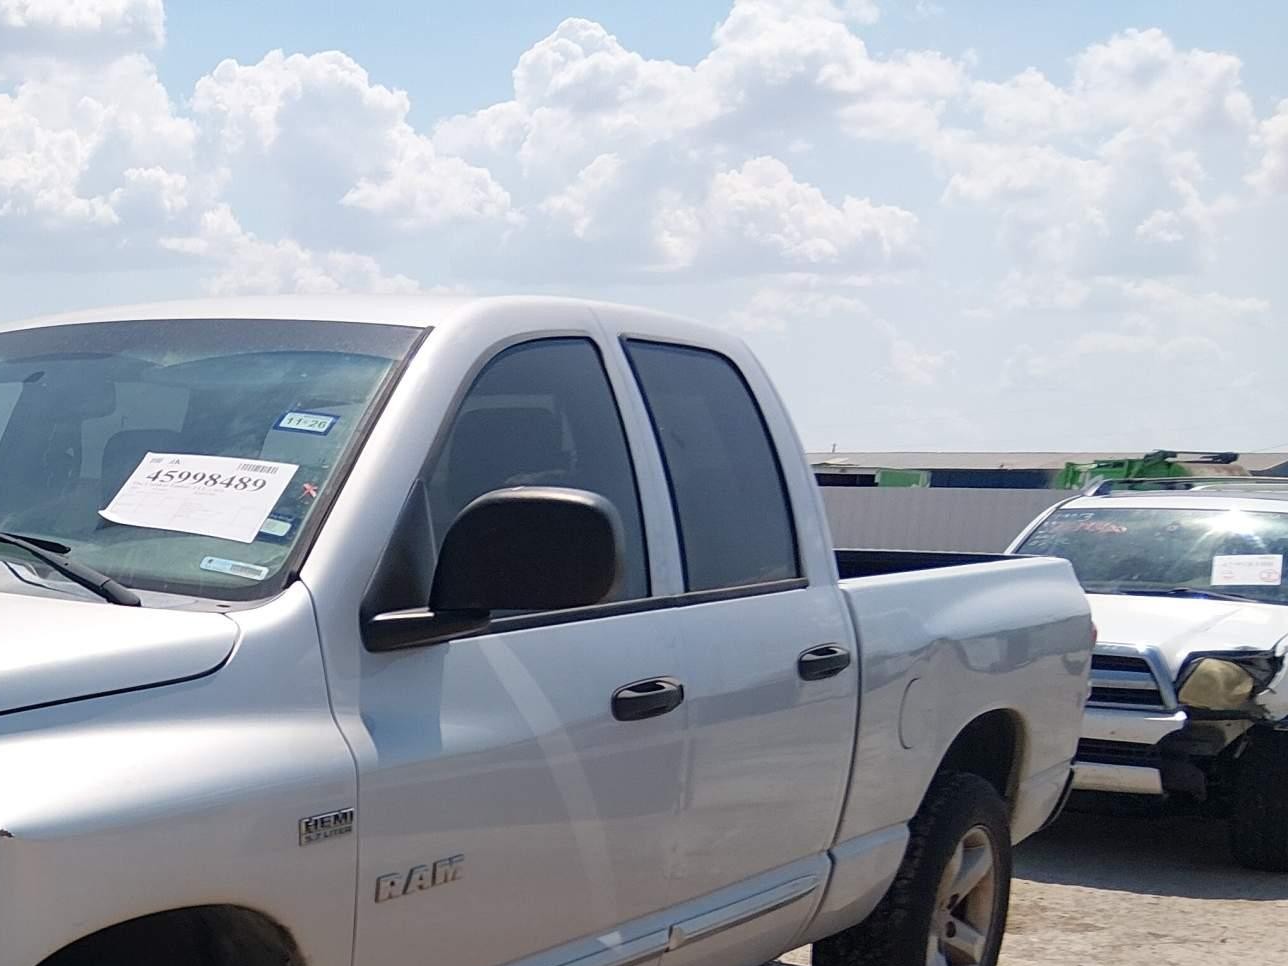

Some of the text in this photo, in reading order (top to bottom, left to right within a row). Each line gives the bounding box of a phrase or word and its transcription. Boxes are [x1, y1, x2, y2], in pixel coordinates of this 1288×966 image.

[146, 468, 267, 492] 45998489
[303, 809, 354, 834] HEMI
[374, 854, 465, 904] RAM
